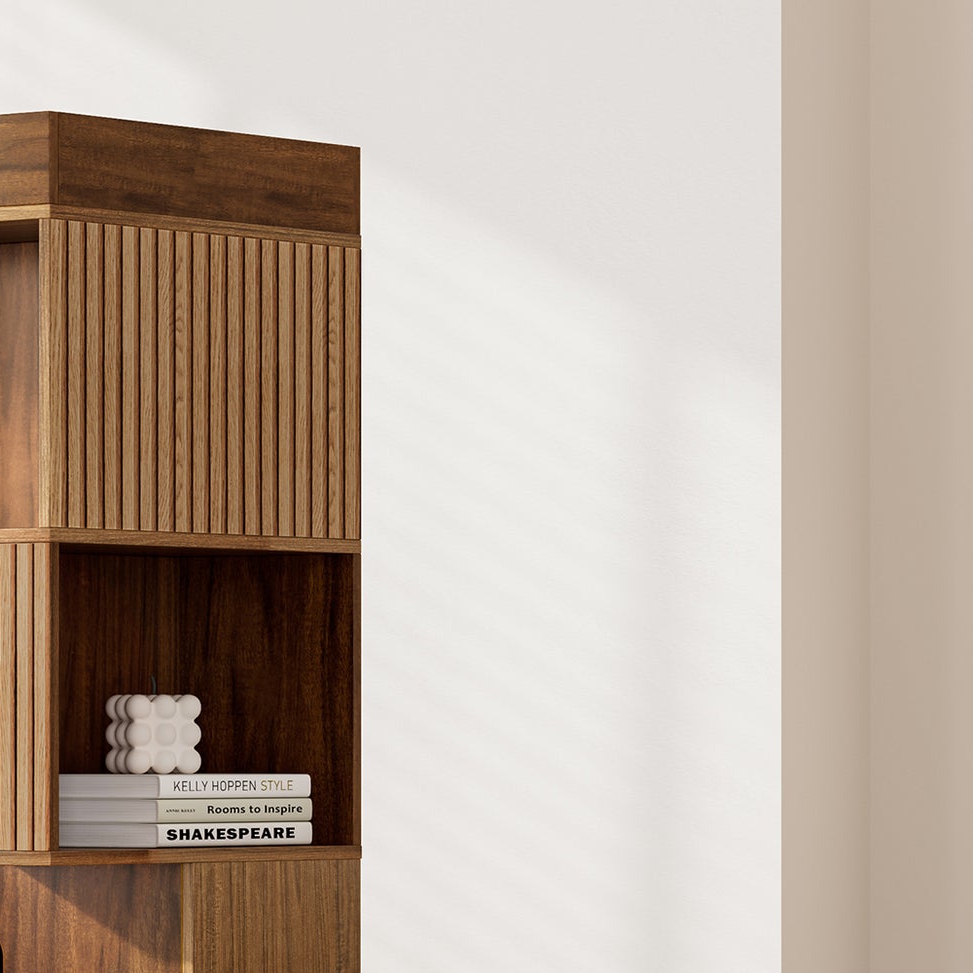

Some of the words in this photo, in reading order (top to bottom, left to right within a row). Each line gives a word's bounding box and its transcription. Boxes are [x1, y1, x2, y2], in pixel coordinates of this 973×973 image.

[173, 780, 208, 792] KELLY
[211, 780, 257, 792] HOPPEN
[260, 779, 294, 791] STYLE
[207, 805, 246, 814] Rooms
[249, 805, 261, 814] to
[264, 804, 303, 816] Inspire
[166, 827, 296, 841] SHAKESPEARE
